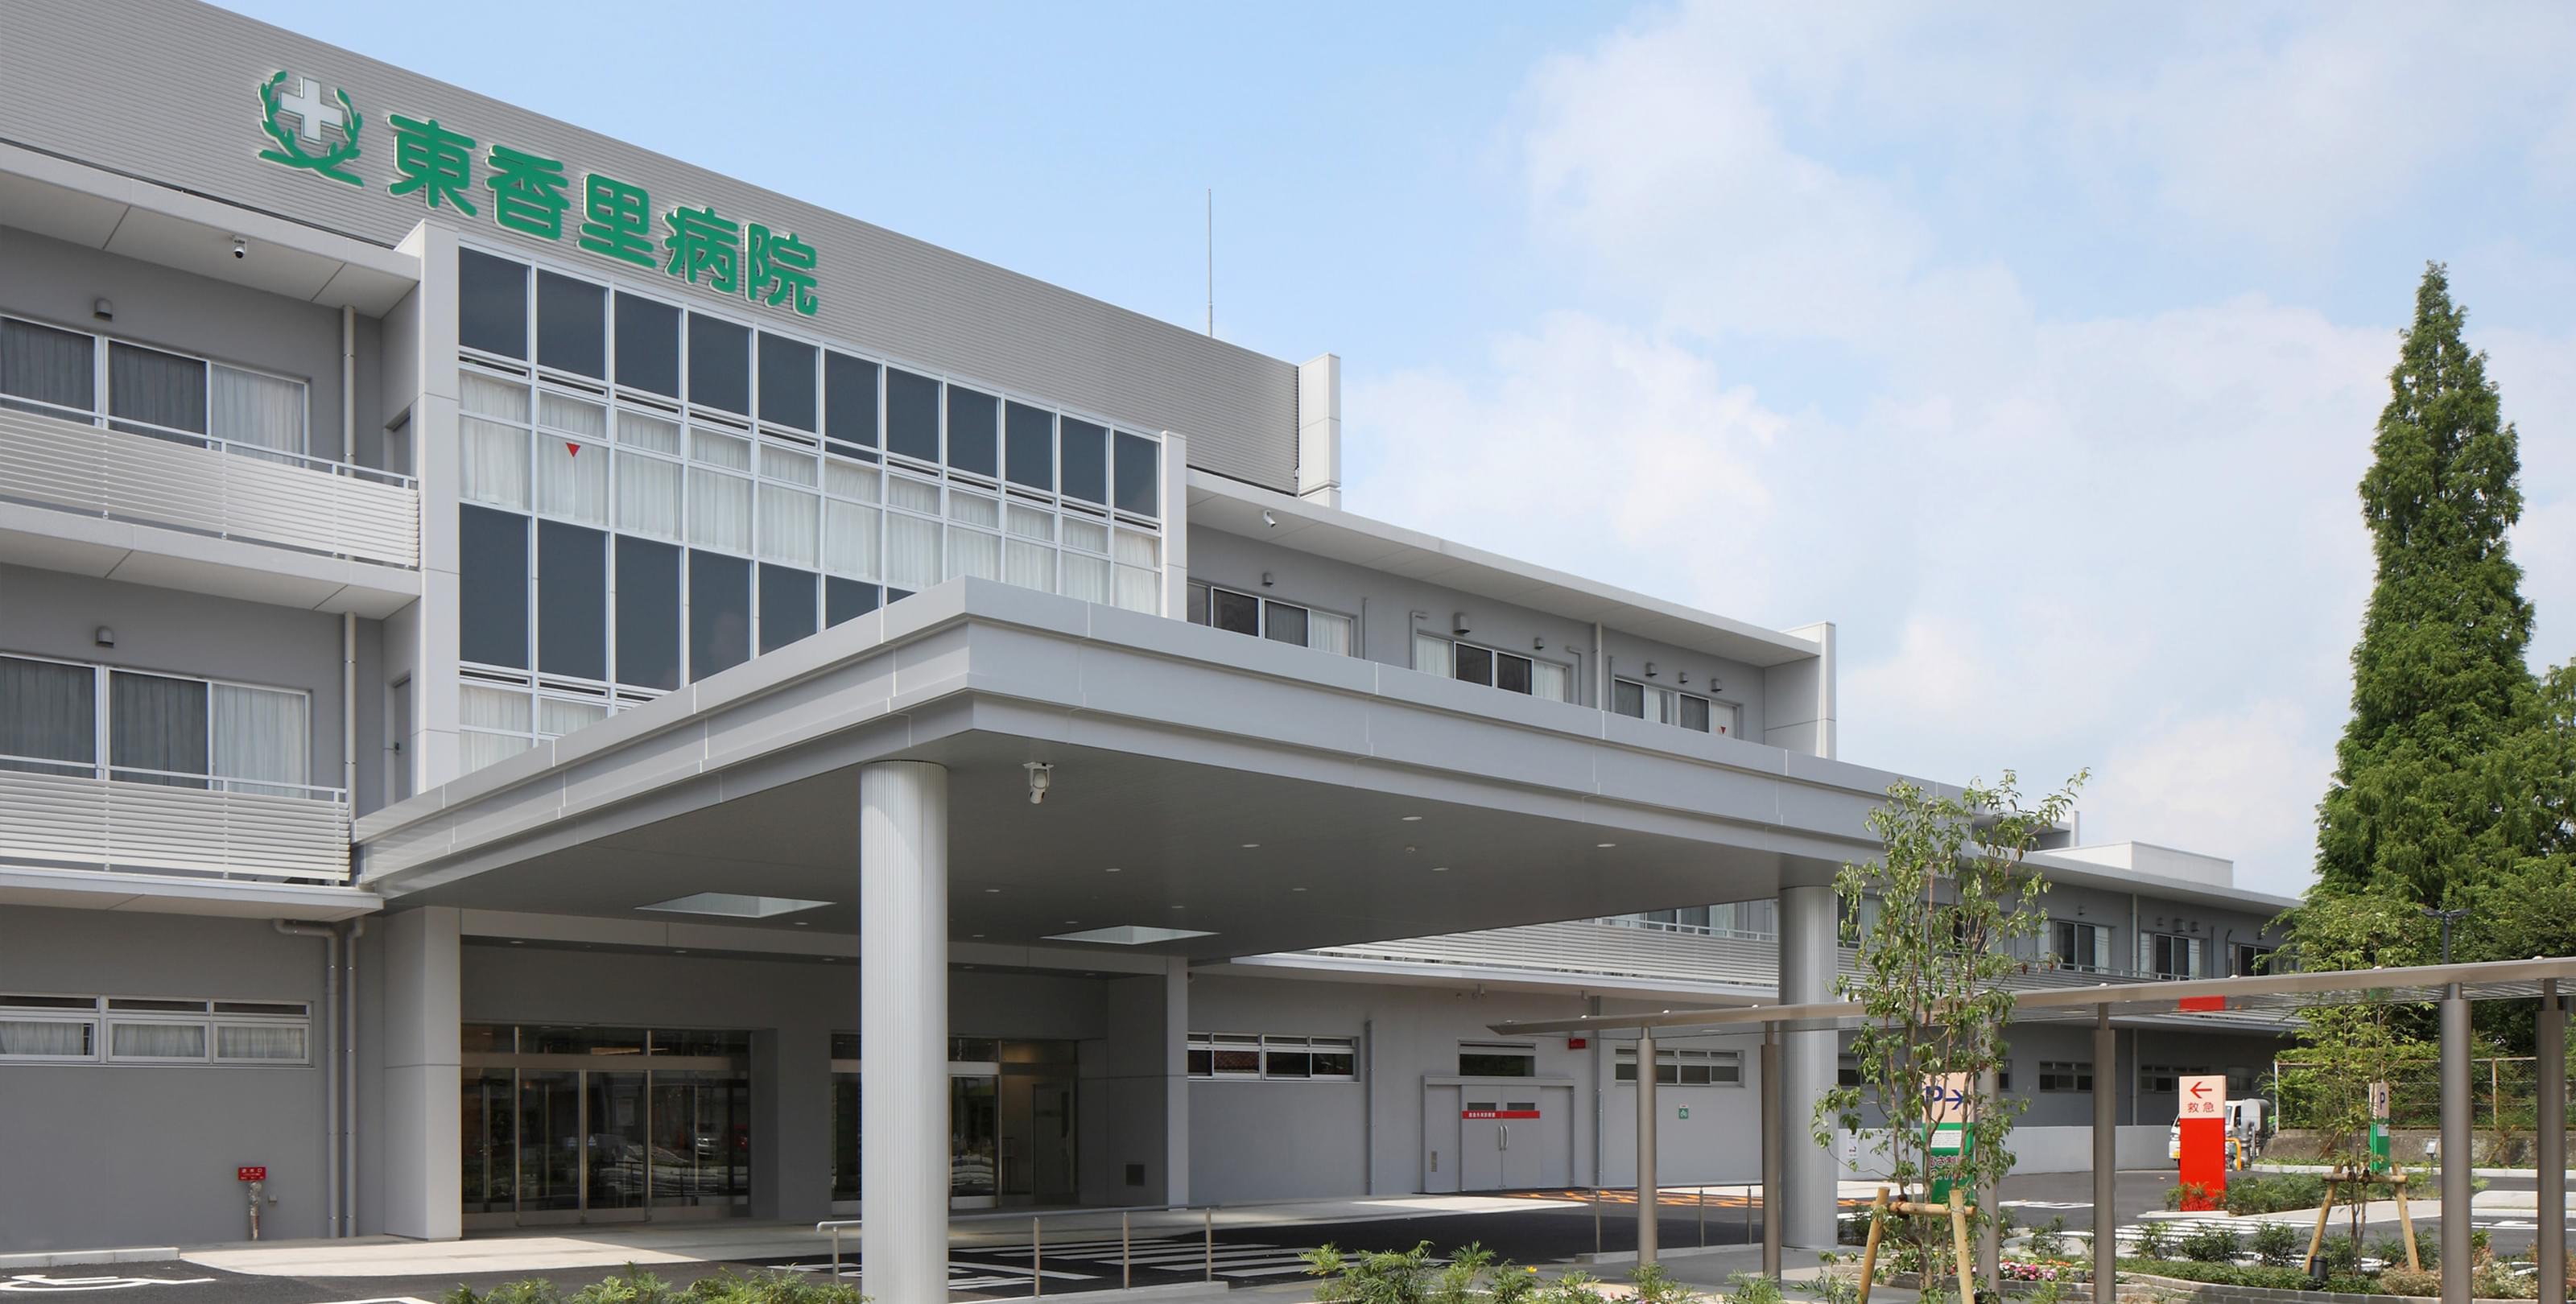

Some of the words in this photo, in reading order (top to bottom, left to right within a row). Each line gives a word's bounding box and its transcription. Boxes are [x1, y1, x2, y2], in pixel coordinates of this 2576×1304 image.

[390, 114, 819, 316] 東香里病院
[1926, 1086, 1944, 1104] P
[2380, 1091, 2385, 1110] P
[2187, 1102, 2215, 1112] 救急
